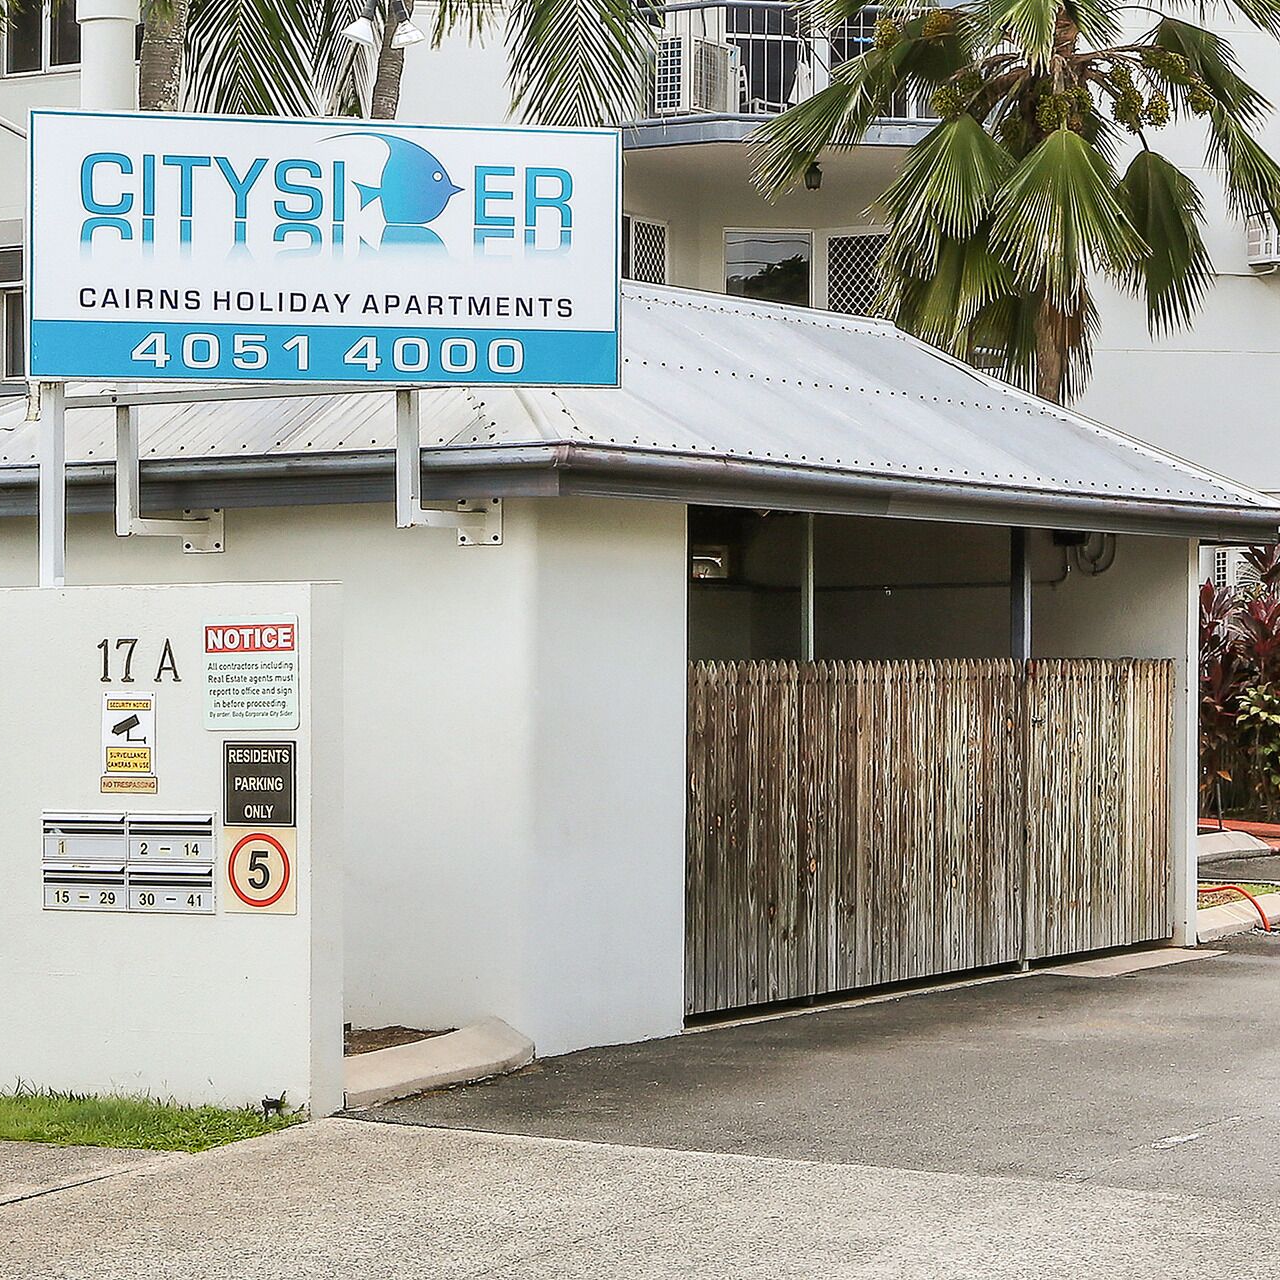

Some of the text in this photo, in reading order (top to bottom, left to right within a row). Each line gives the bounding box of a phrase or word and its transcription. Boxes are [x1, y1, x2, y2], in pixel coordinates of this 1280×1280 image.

[79, 287, 573, 318] CAIRNS HOLIDAY APARTMENTS
[130, 332, 525, 374] 4051 4000
[207, 627, 292, 649] NOTICE
[97, 638, 182, 682] 17 A
[208, 661, 293, 671] All contractors including
[208, 674, 293, 684] Real Estate agents must
[209, 688, 231, 697] report
[241, 687, 260, 695] office
[261, 687, 275, 695] and
[277, 686, 292, 696] sign
[214, 700, 220, 708] in
[222, 700, 245, 708] before
[109, 751, 147, 759] SURVEILLANCE
[228, 749, 290, 763] RESIDENTS
[107, 761, 132, 769] CAMERAS
[103, 781, 155, 789] NO TRESPASSING
[234, 777, 283, 791] PARKING
[244, 804, 274, 819] ONLY
[58, 840, 65, 854] 1
[140, 842, 148, 856] 2
[184, 843, 199, 856] 14
[248, 850, 270, 889] 5
[54, 890, 70, 903] 15
[99, 891, 115, 904] 29
[139, 892, 155, 906] 30
[187, 894, 202, 907] 41
